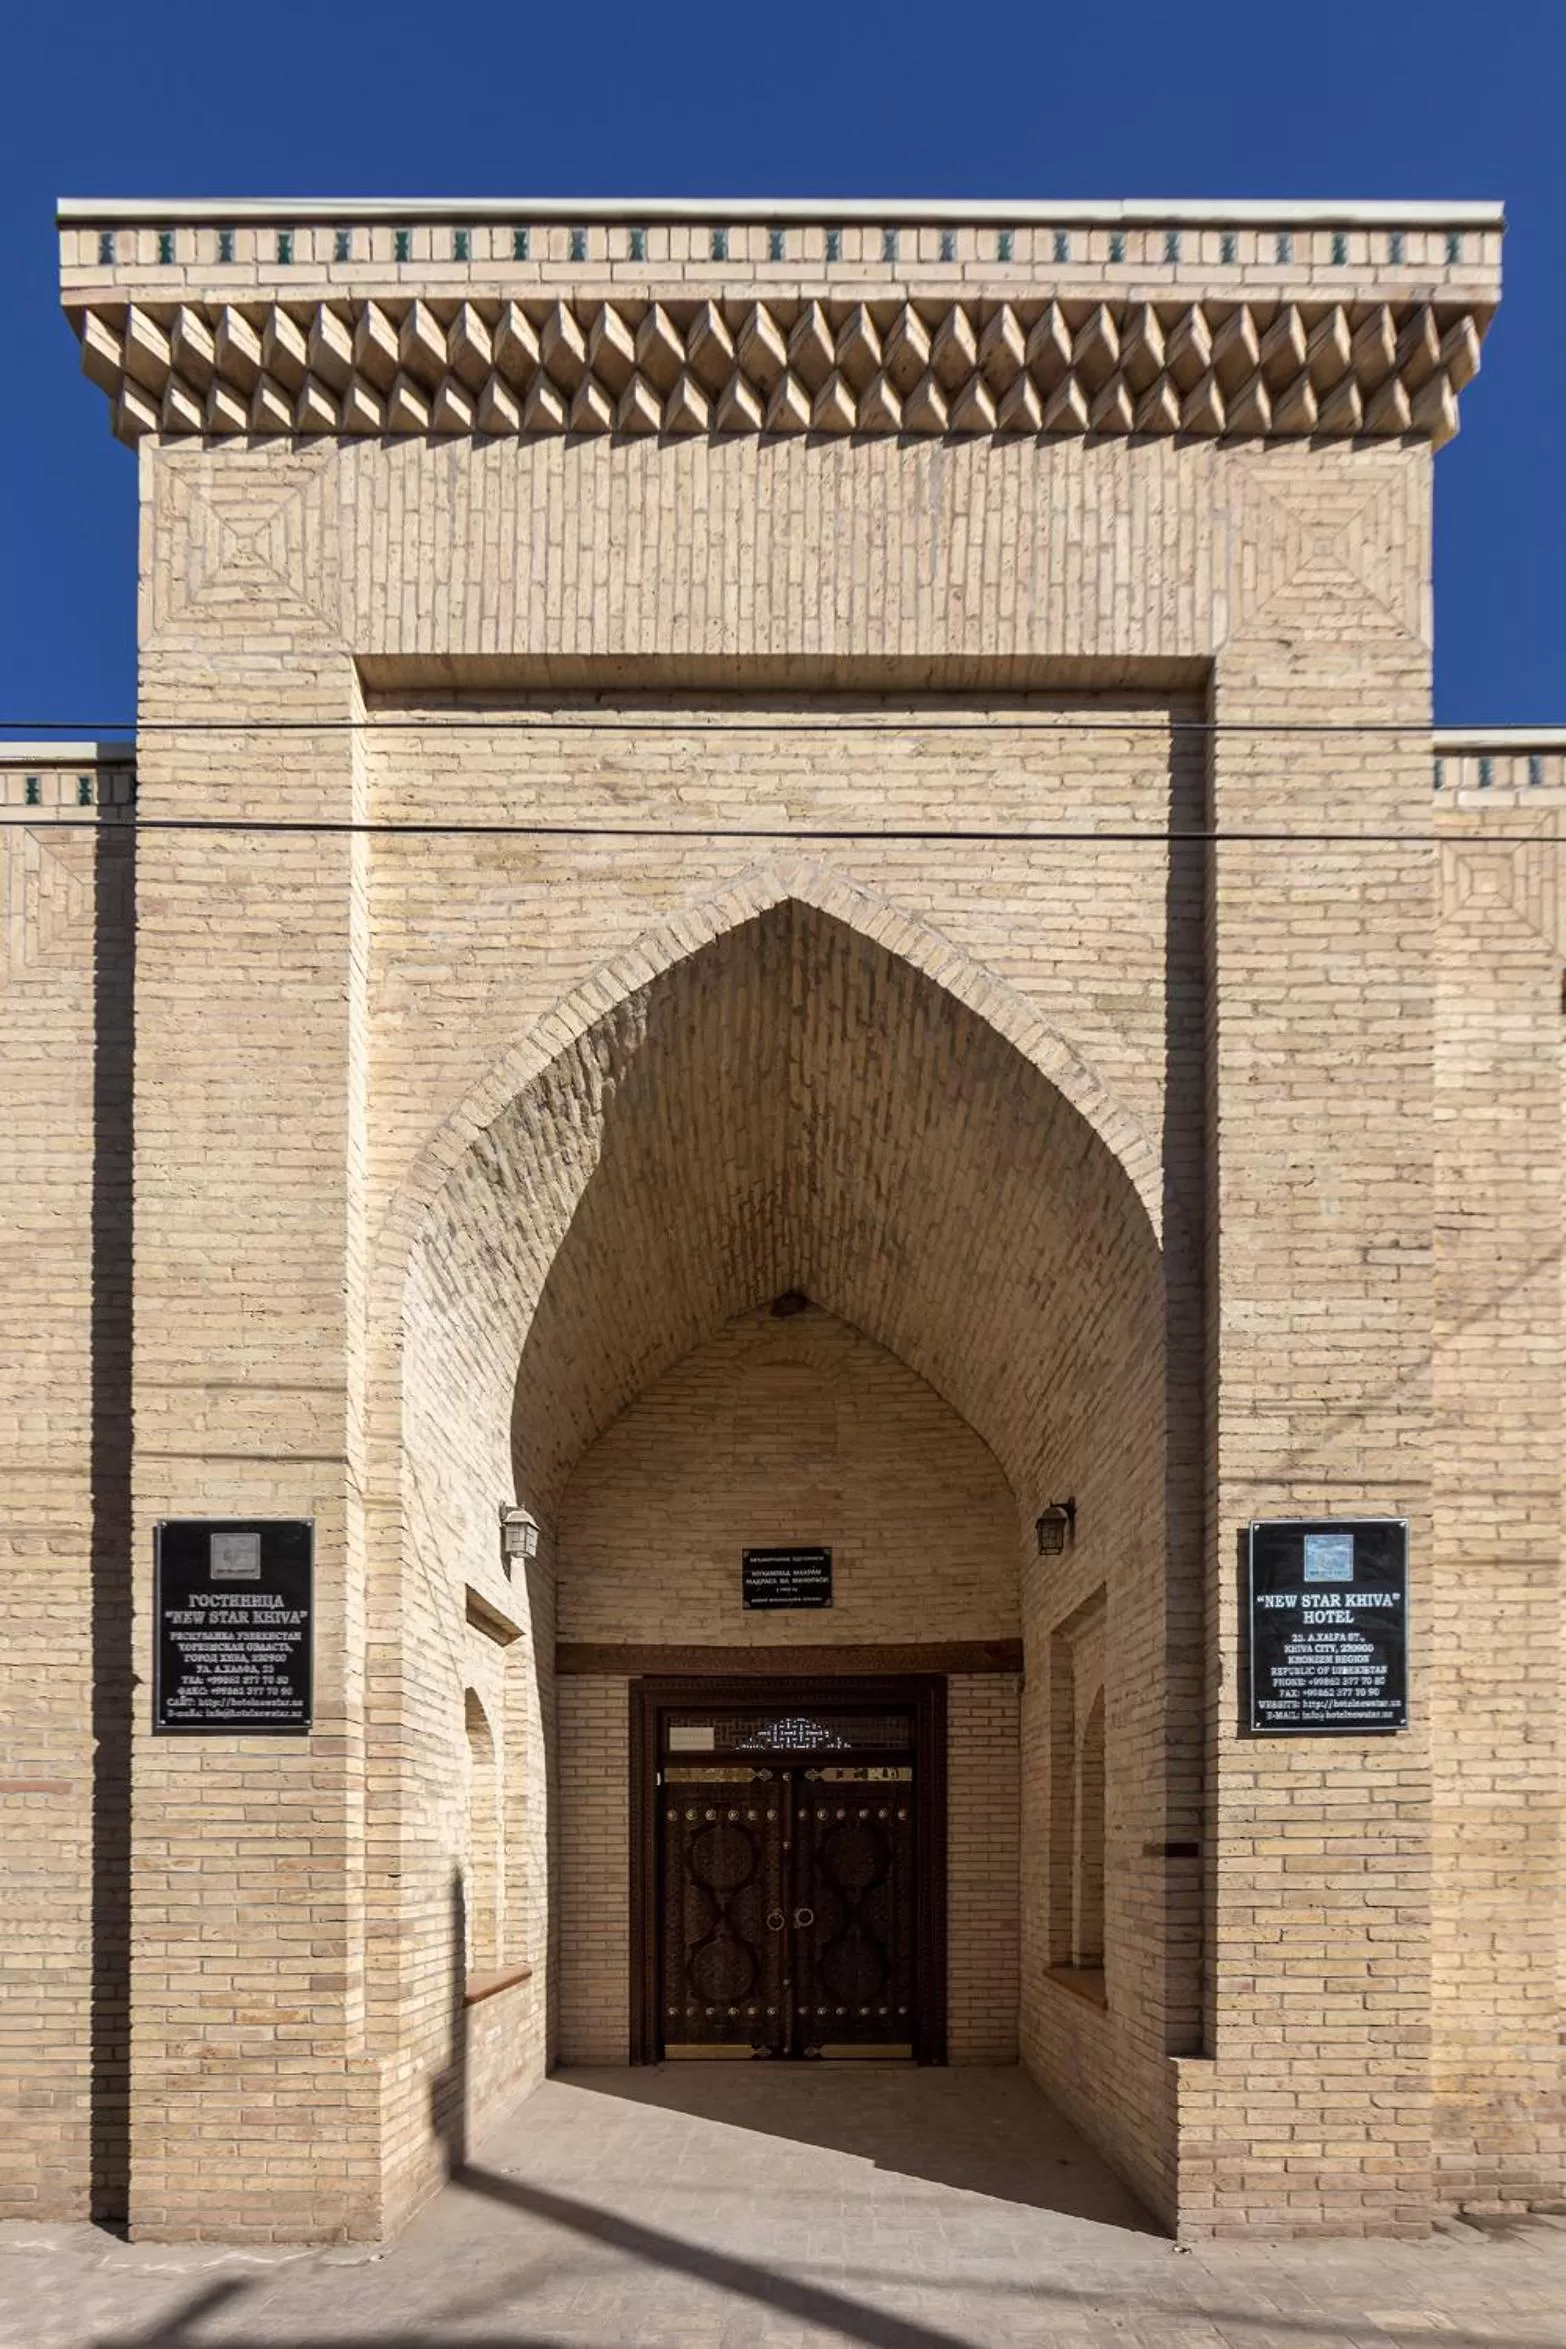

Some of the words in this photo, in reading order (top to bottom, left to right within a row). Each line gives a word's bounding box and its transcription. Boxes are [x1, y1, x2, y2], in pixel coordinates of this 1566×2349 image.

[188, 1594, 284, 1609] ГОСТИНИЦА
[1301, 1594, 1342, 1608] STAR
[208, 1611, 249, 1624] STAR
[1303, 1610, 1354, 1624] HOTEL
[235, 1631, 301, 1641] УЗБЕКИСТАН
[1284, 1644, 1313, 1653] KHIVA
[1314, 1643, 1339, 1654] CITY,
[184, 1653, 218, 1663] ГОРОД
[220, 1653, 249, 1663] ХИВА,
[1335, 1654, 1370, 1664] REGION
[1270, 1666, 1315, 1676] REPUBLIC
[1317, 1666, 1330, 1675] OF
[1332, 1665, 1388, 1675] UZBEKISTAN
[1272, 1678, 1306, 1687] PHONE:
[1361, 1677, 1372, 1686] 70
[1279, 1688, 1300, 1698] FAX:
[1355, 1688, 1366, 1697] 70
[1258, 1699, 1301, 1709] WEBSITE:
[1266, 1711, 1301, 1720] E-MAIL:
